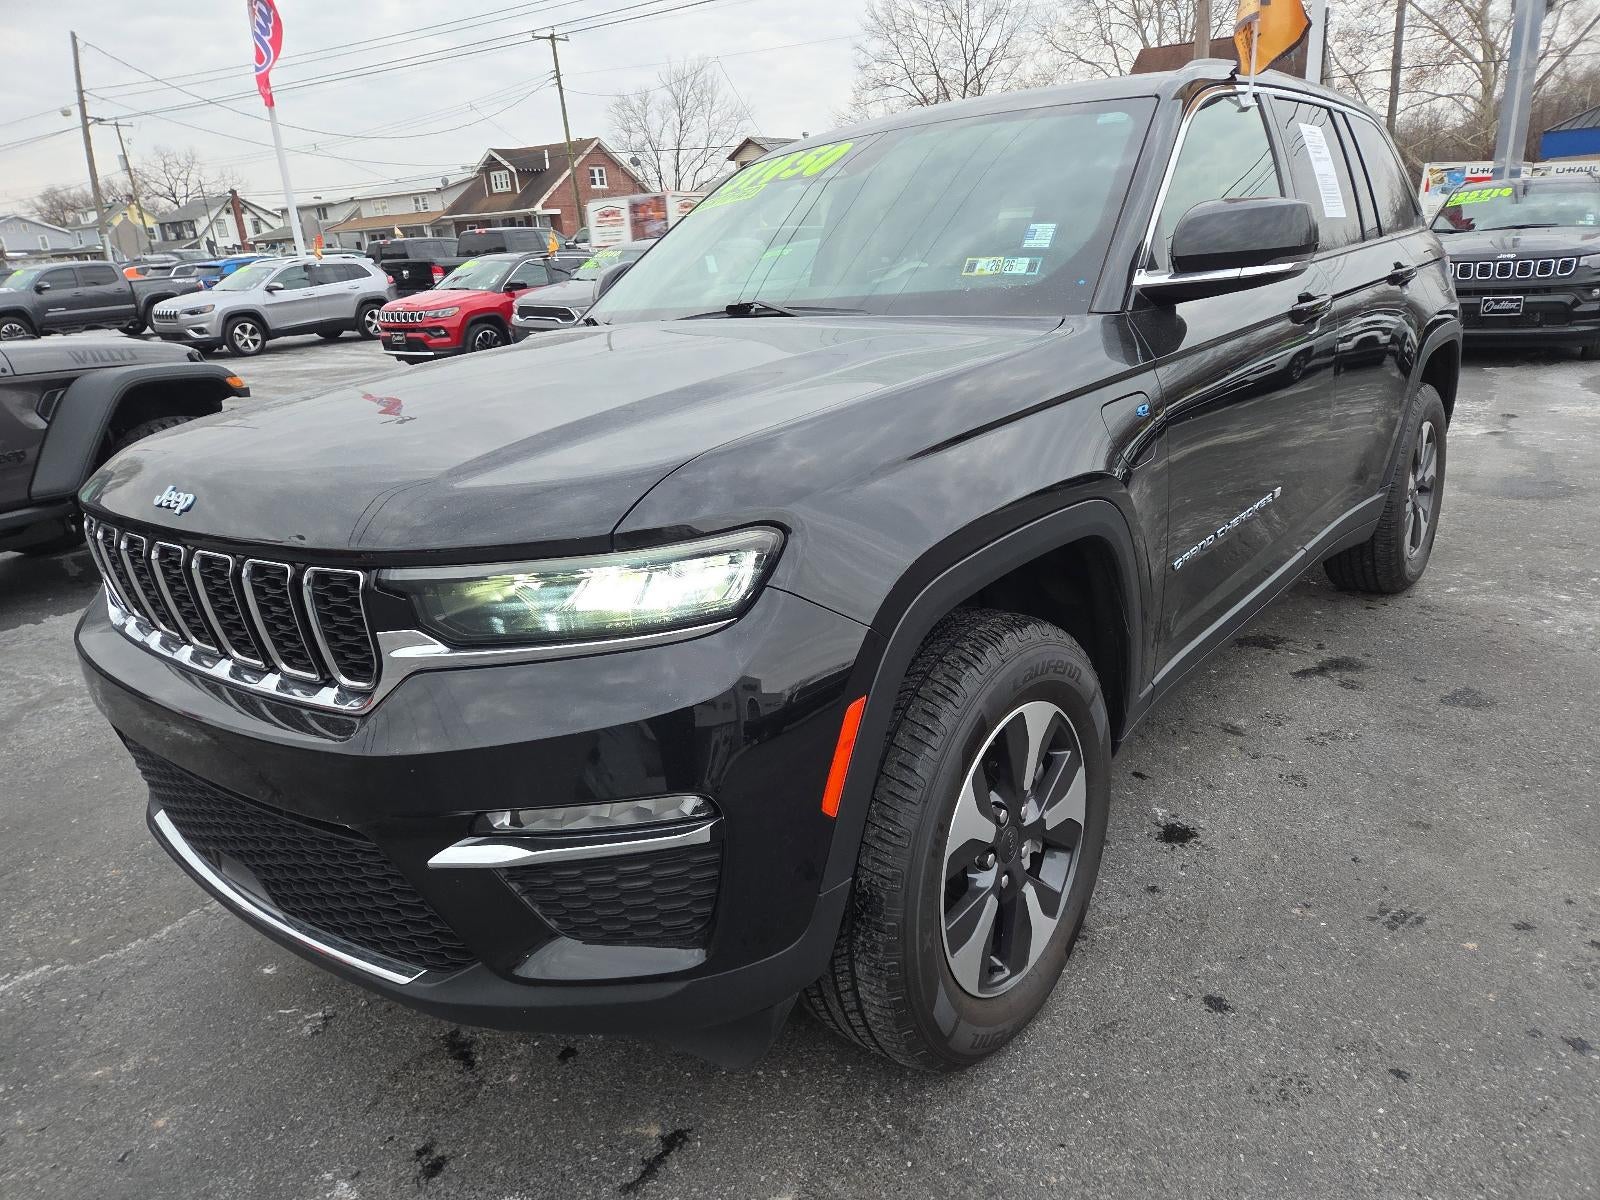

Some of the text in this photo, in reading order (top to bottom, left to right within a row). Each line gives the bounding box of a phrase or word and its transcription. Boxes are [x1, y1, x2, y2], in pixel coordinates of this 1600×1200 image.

[1003, 259, 1016, 272] 26
[153, 485, 196, 516] Jeep
[1172, 534, 1215, 571] GRAND
